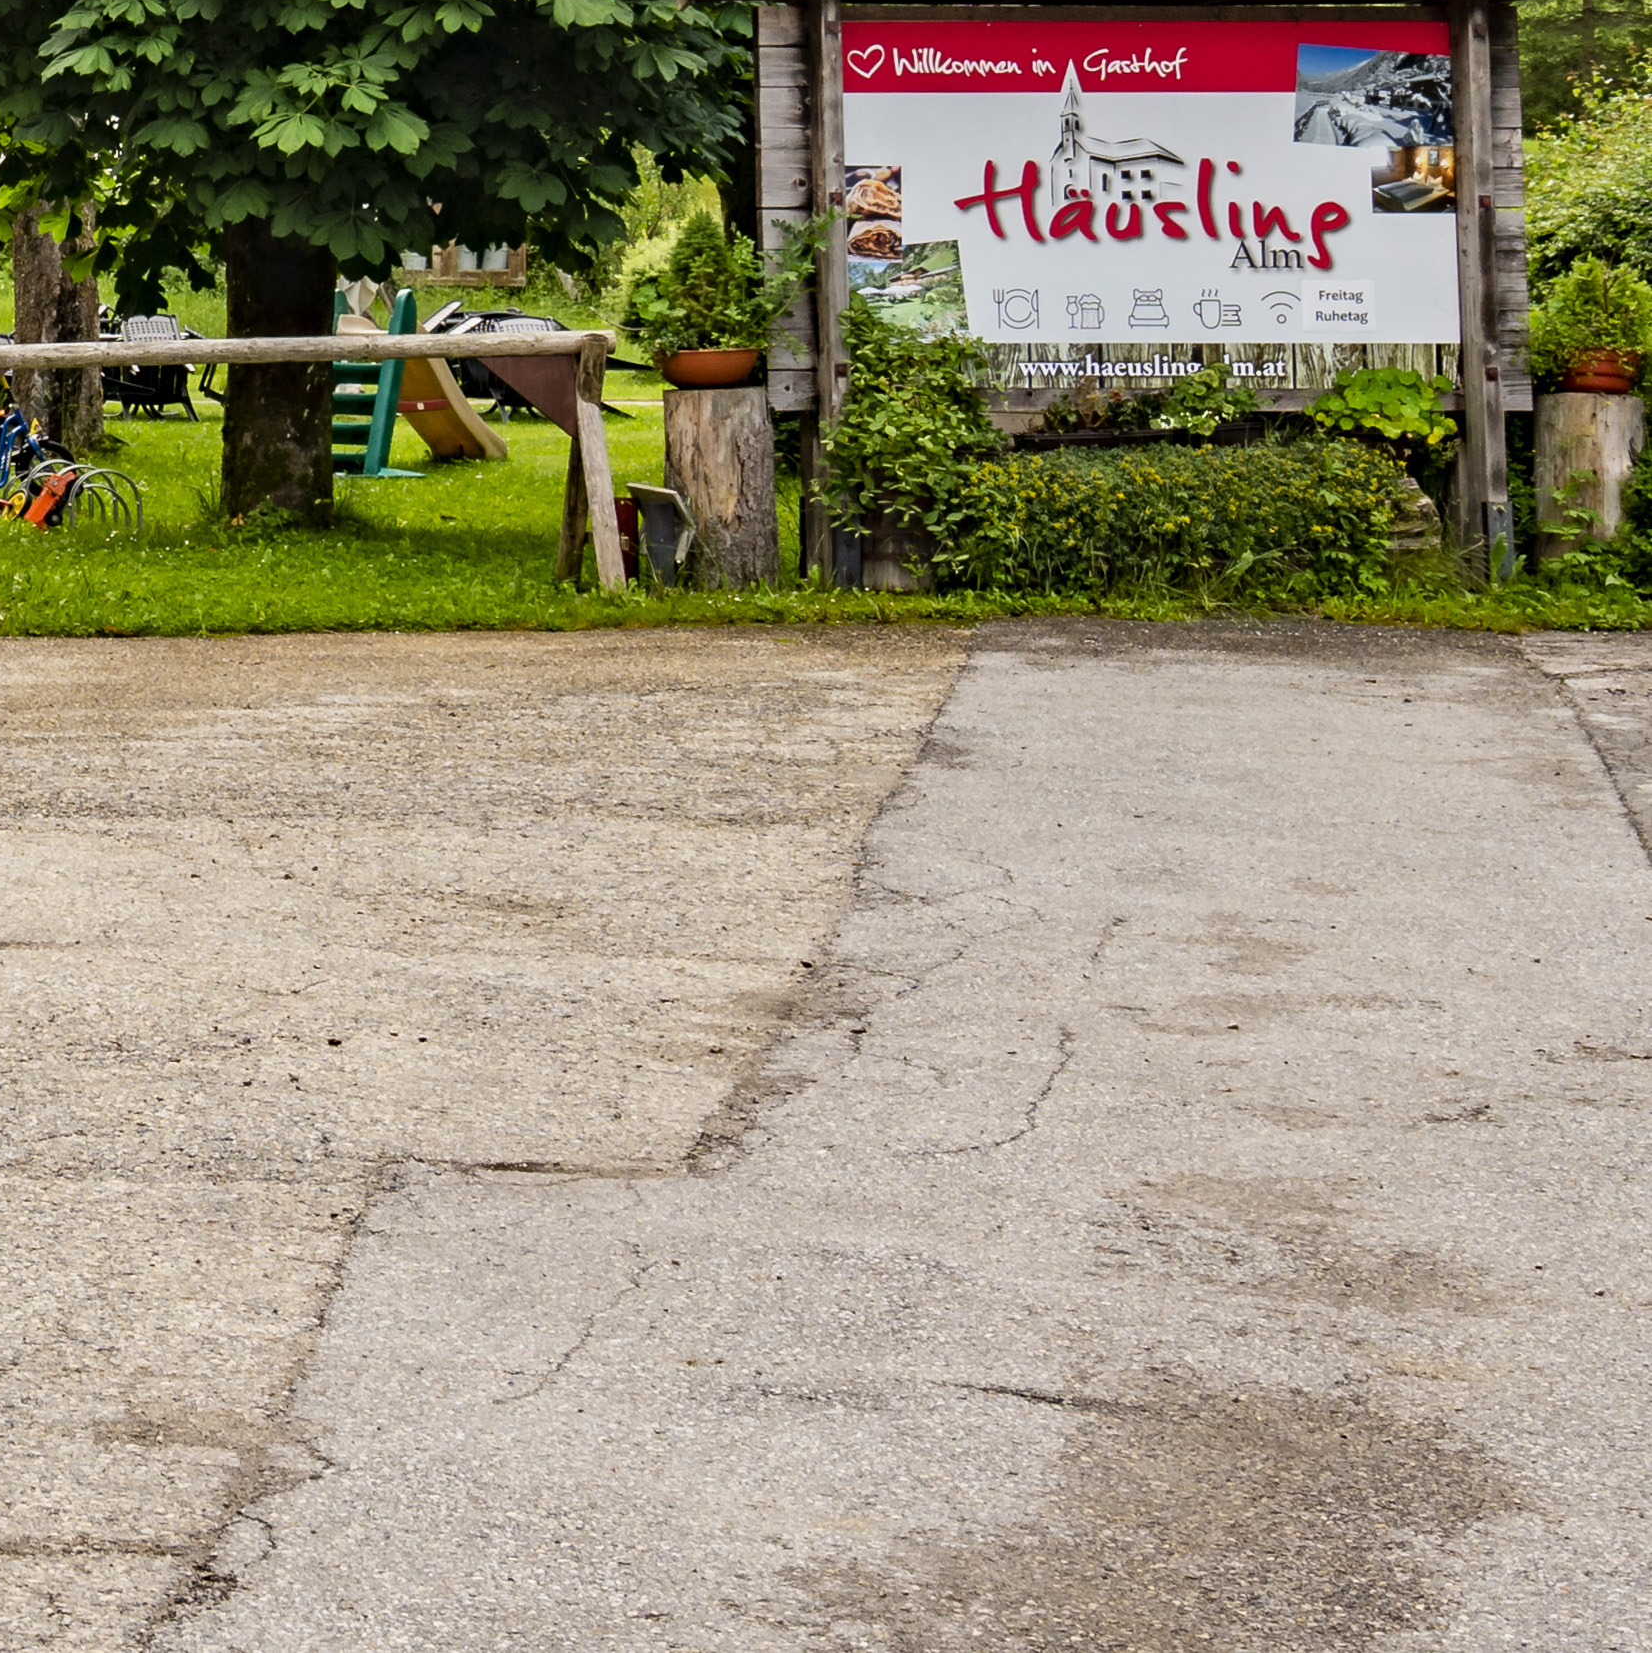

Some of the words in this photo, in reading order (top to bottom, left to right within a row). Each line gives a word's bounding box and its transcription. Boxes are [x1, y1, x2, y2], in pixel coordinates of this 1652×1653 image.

[892, 47, 1023, 77] Willkommen
[1083, 47, 1189, 81] Gasthof
[953, 157, 1350, 270] Häusling
[1228, 240, 1304, 269] Alm
[1318, 289, 1364, 304] Freitag
[1315, 310, 1369, 325] Ruhetag
[1018, 353, 1286, 377] www.haeuslinglm.at
